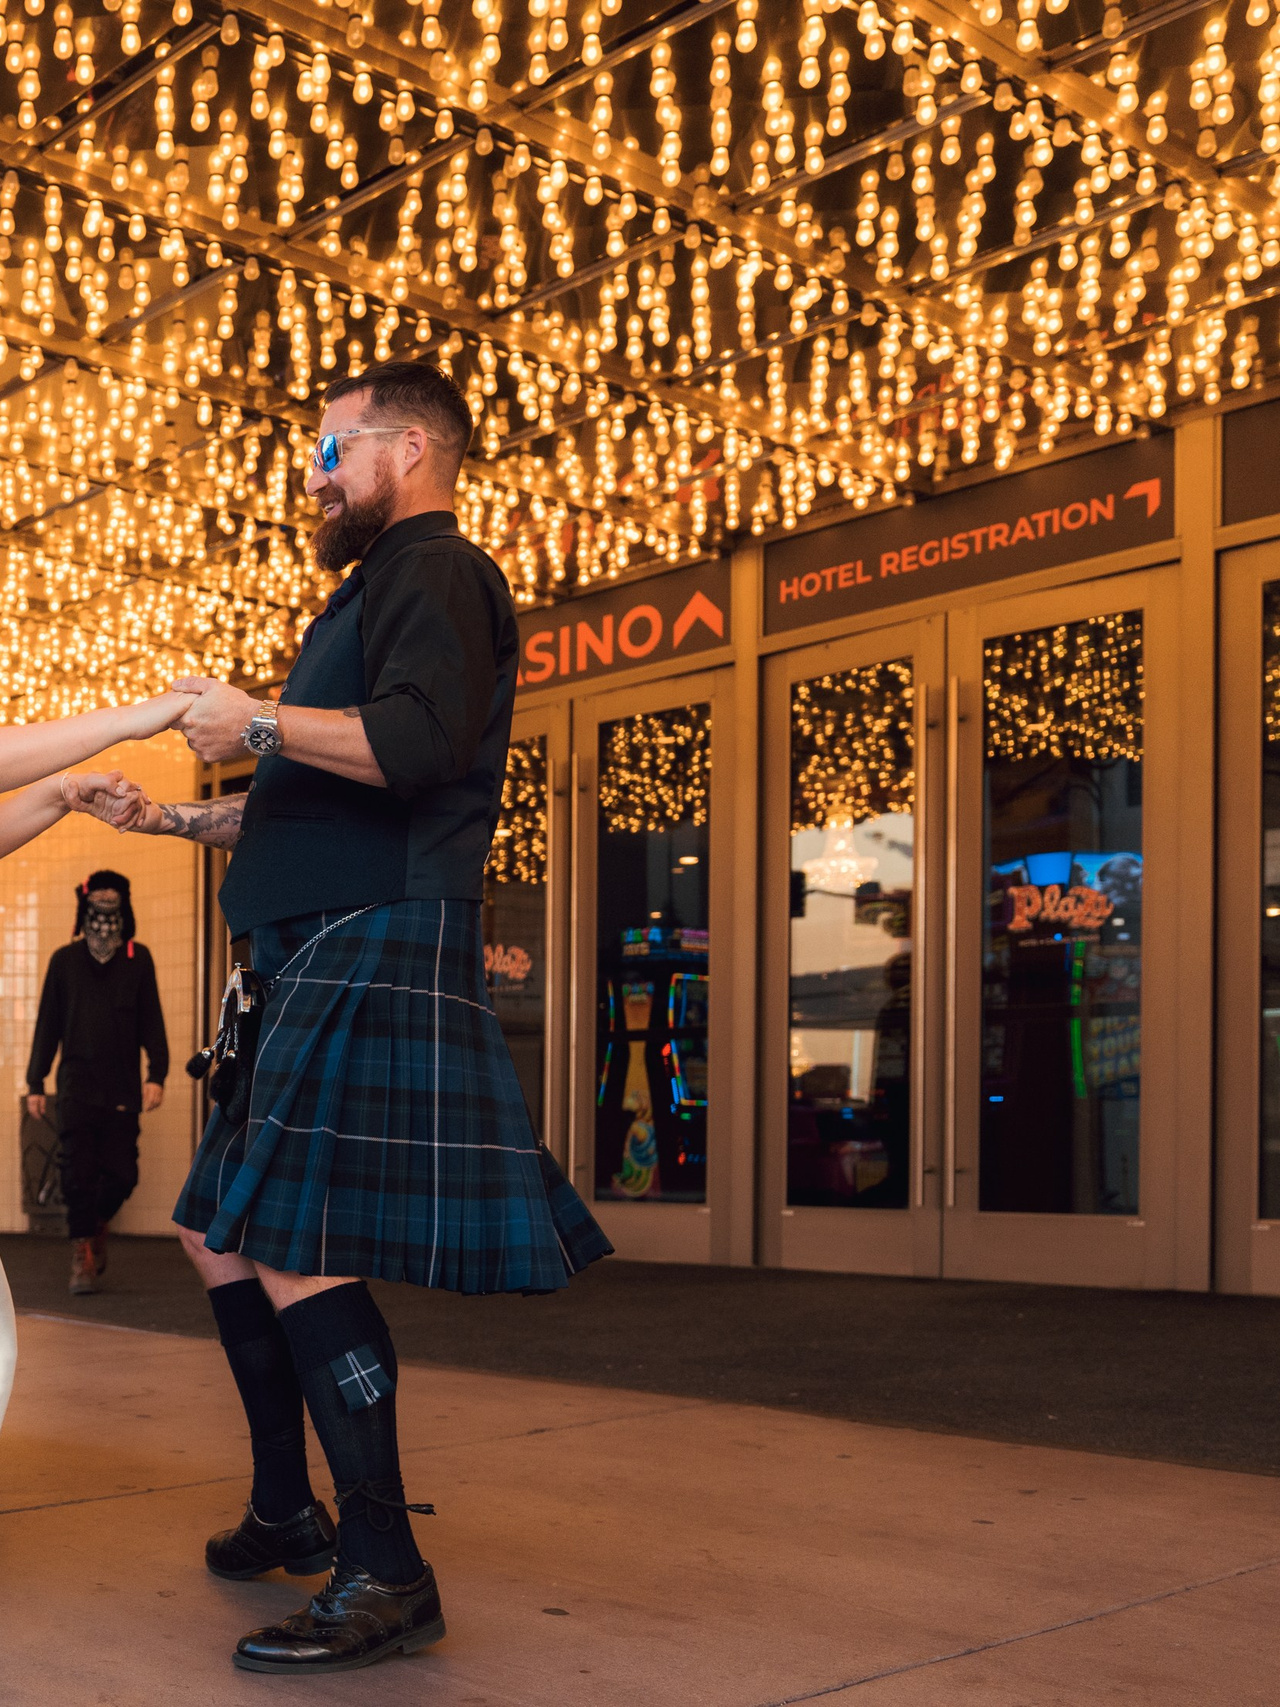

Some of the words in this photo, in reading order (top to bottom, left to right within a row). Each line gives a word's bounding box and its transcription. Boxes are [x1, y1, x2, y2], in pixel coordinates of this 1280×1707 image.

[779, 559, 872, 604] HOTEL
[880, 494, 1115, 578] REGISTRATION
[516, 604, 663, 686] SINO
[1007, 884, 1114, 932] Plaza
